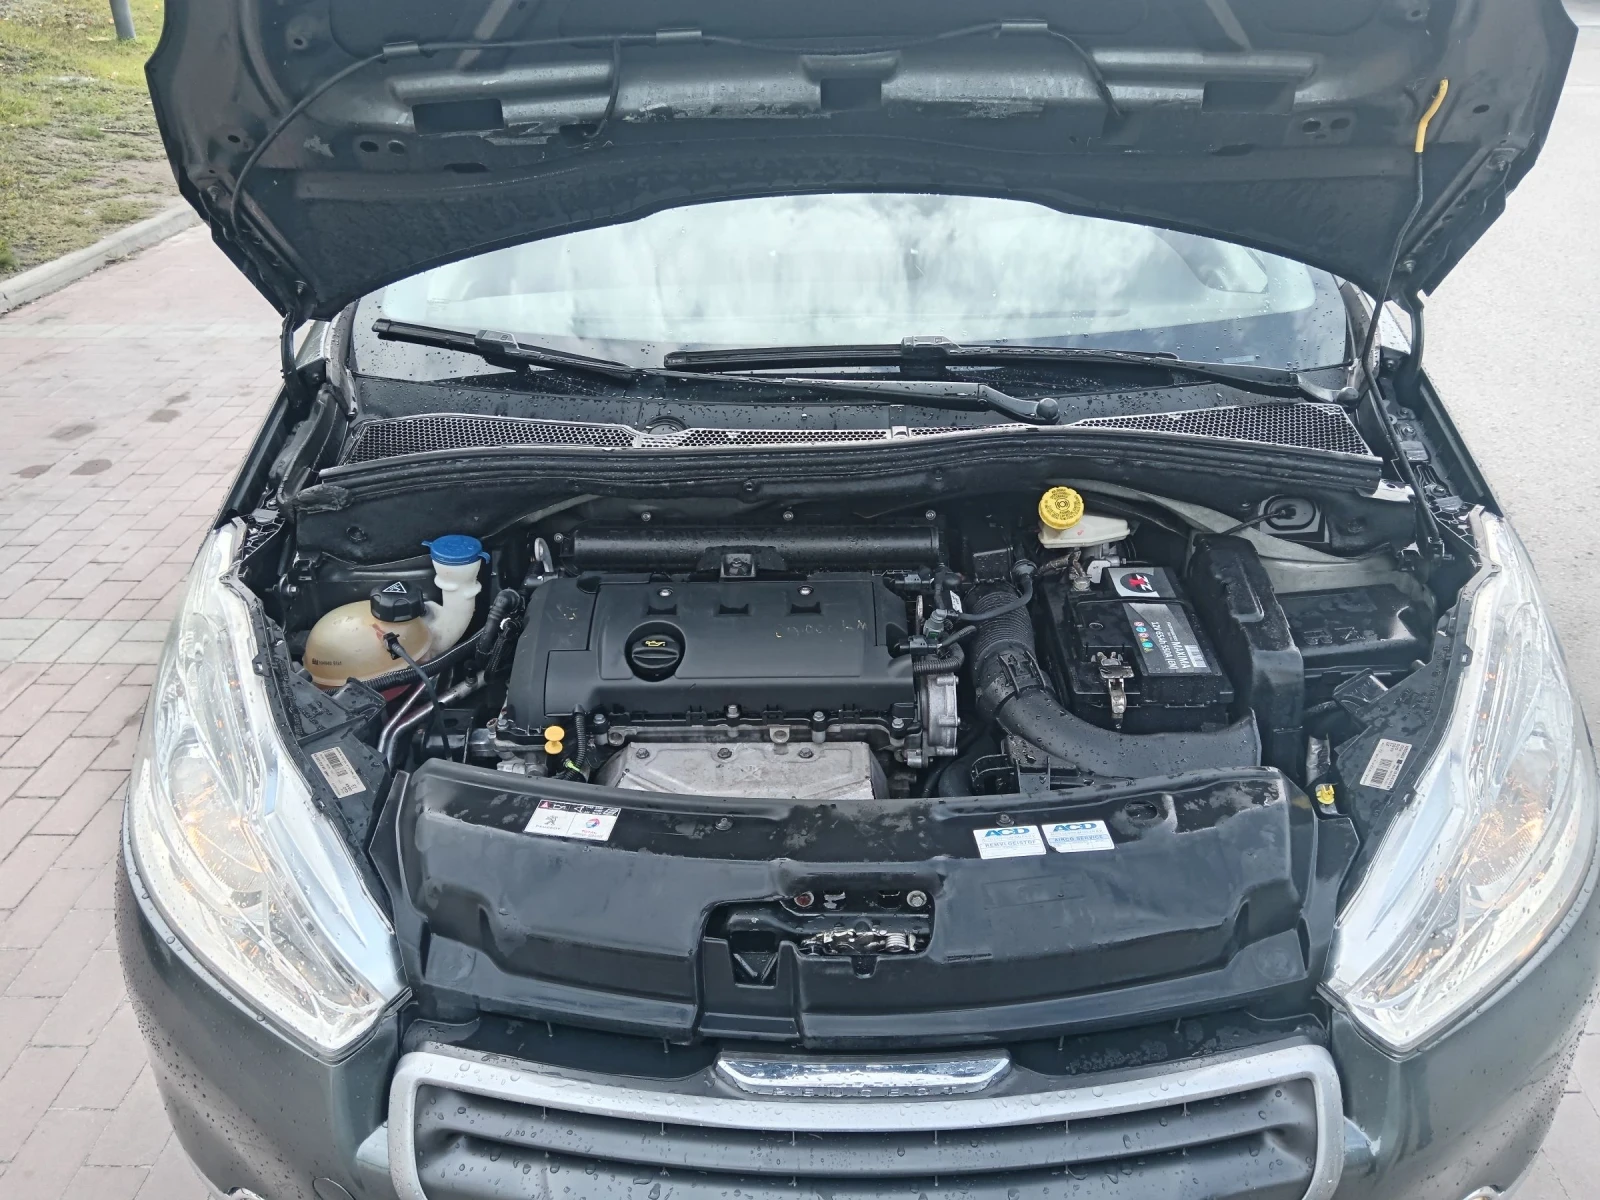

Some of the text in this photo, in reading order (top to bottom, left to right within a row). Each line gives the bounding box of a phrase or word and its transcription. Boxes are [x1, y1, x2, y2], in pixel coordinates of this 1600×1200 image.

[1151, 621, 1162, 631] 12V
[1171, 641, 1191, 669] MAXIMA
[1076, 834, 1104, 842] SERVICE
[772, 1086, 957, 1098] PEUGEOT
